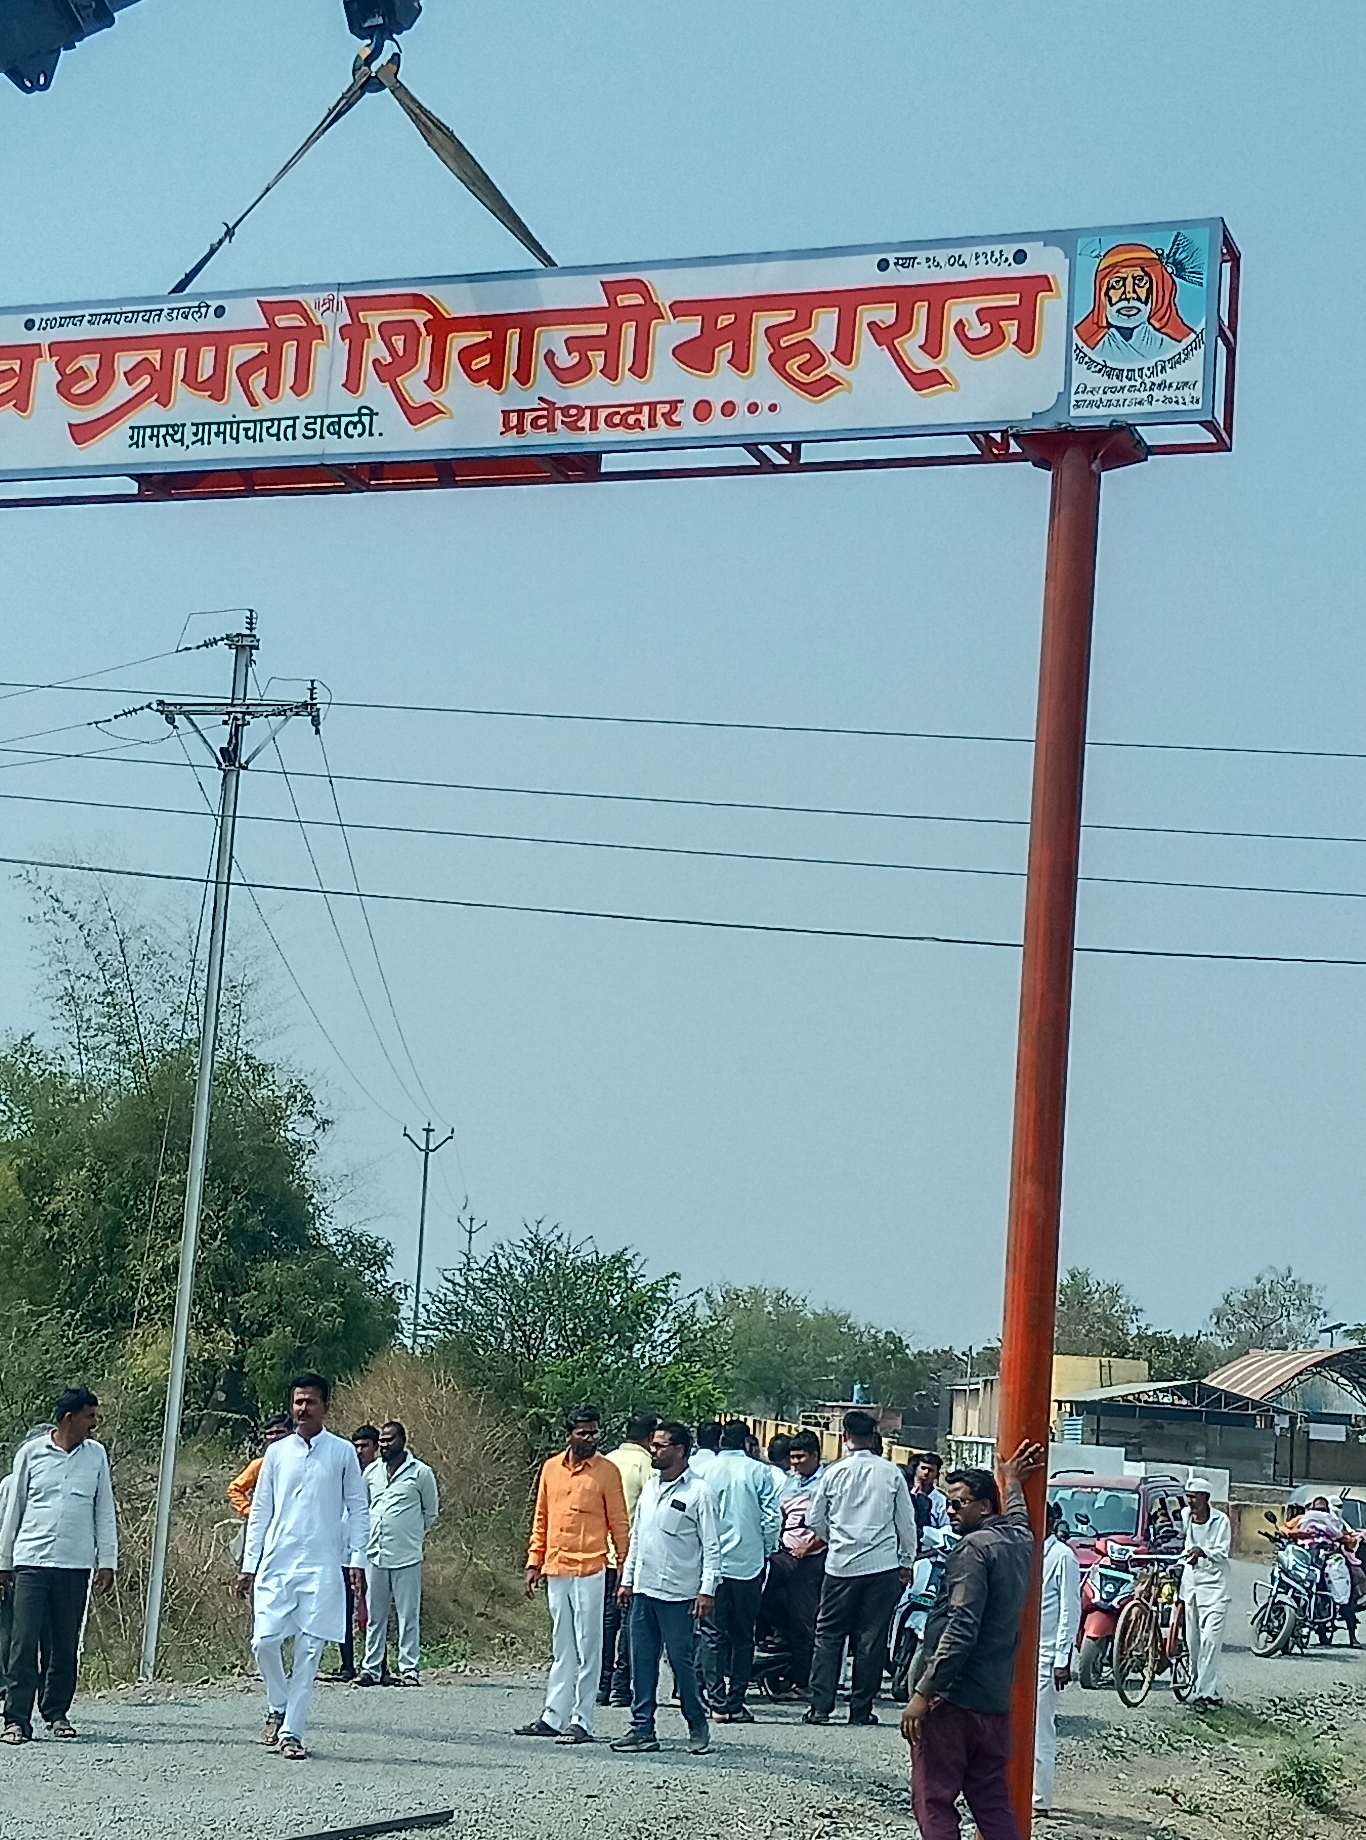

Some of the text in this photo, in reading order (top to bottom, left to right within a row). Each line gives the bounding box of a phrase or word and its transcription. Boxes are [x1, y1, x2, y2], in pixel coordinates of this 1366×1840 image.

[164, 301, 211, 322] डाबली
[48, 299, 327, 449] छत्रपती
[340, 278, 666, 430] शिवाजी
[669, 274, 1060, 399] महाराज
[191, 414, 299, 445] ग्रामपंचायत
